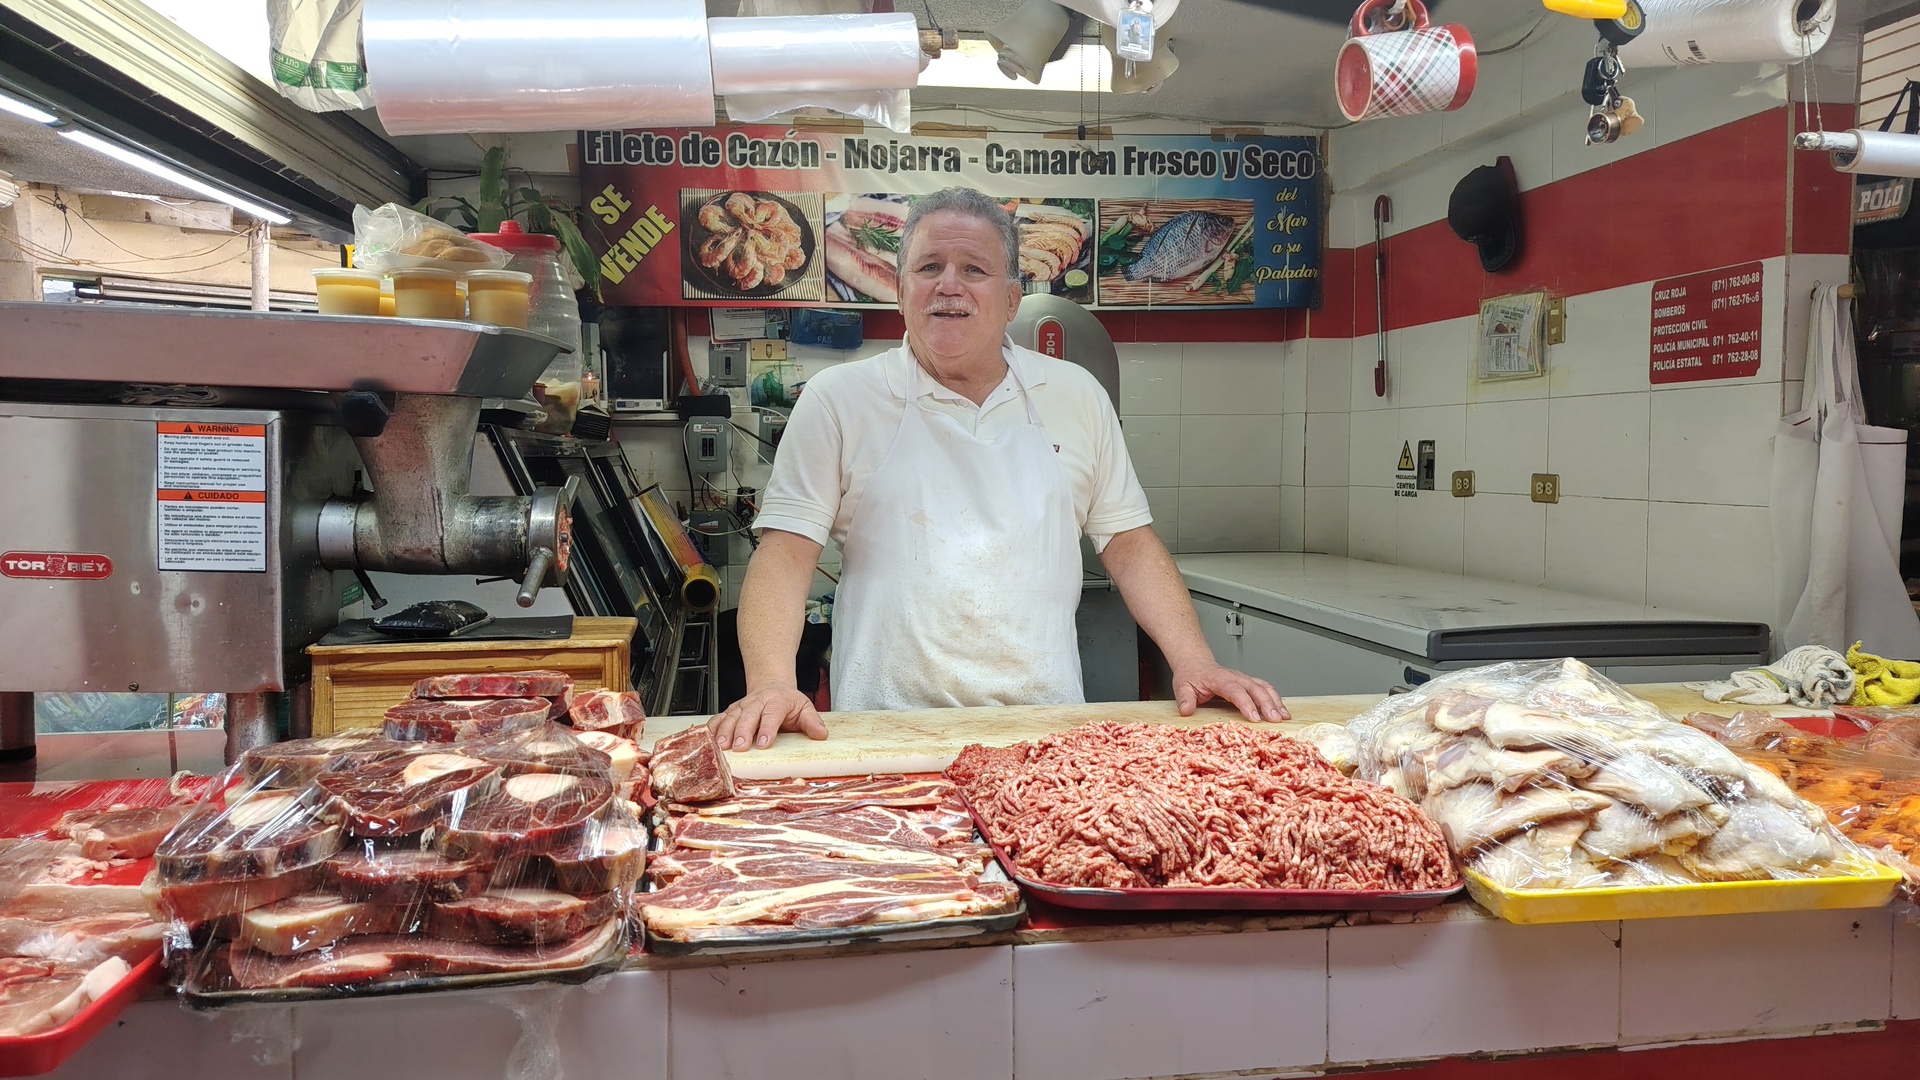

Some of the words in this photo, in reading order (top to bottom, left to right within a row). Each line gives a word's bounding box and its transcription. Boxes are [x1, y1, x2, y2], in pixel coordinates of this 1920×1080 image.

[585, 130, 674, 166] Filete
[680, 132, 721, 167] de
[726, 130, 821, 169] Cazón
[844, 138, 962, 174] Mojarra
[1123, 145, 1218, 177] Fresco
[1221, 150, 1238, 180] y
[1244, 144, 1317, 180] Seco
[590, 184, 632, 225] SE
[1275, 187, 1299, 203] del
[1858, 184, 1904, 212] POLO
[1266, 210, 1310, 233] Mar
[599, 204, 677, 285] VENDE
[1271, 243, 1284, 256] a
[1285, 240, 1305, 256] su
[1255, 264, 1321, 284] Paladar
[1654, 290, 1670, 302] CRUZ
[1671, 287, 1687, 300] ROJA
[1712, 278, 1728, 294] (871)
[1729, 272, 1760, 288] 762-00-88
[1654, 304, 1686, 319] BOMBEROS
[1712, 298, 1727, 312] (871)
[1653, 321, 1690, 337] PROTECCION
[1692, 319, 1708, 331] CIVIL
[1046, 332, 1056, 355] TOR
[1677, 337, 1710, 352] MUNICIPAL
[1712, 336, 1724, 347] 871
[1728, 330, 1758, 345] 762-40-11
[1676, 356, 1702, 369] ESTATAL
[1712, 354, 1724, 365] 871
[198, 424, 240, 434] WARNING
[198, 492, 240, 500] CUIDADO
[5, 560, 46, 570] TOR
[68, 562, 106, 572] REY
